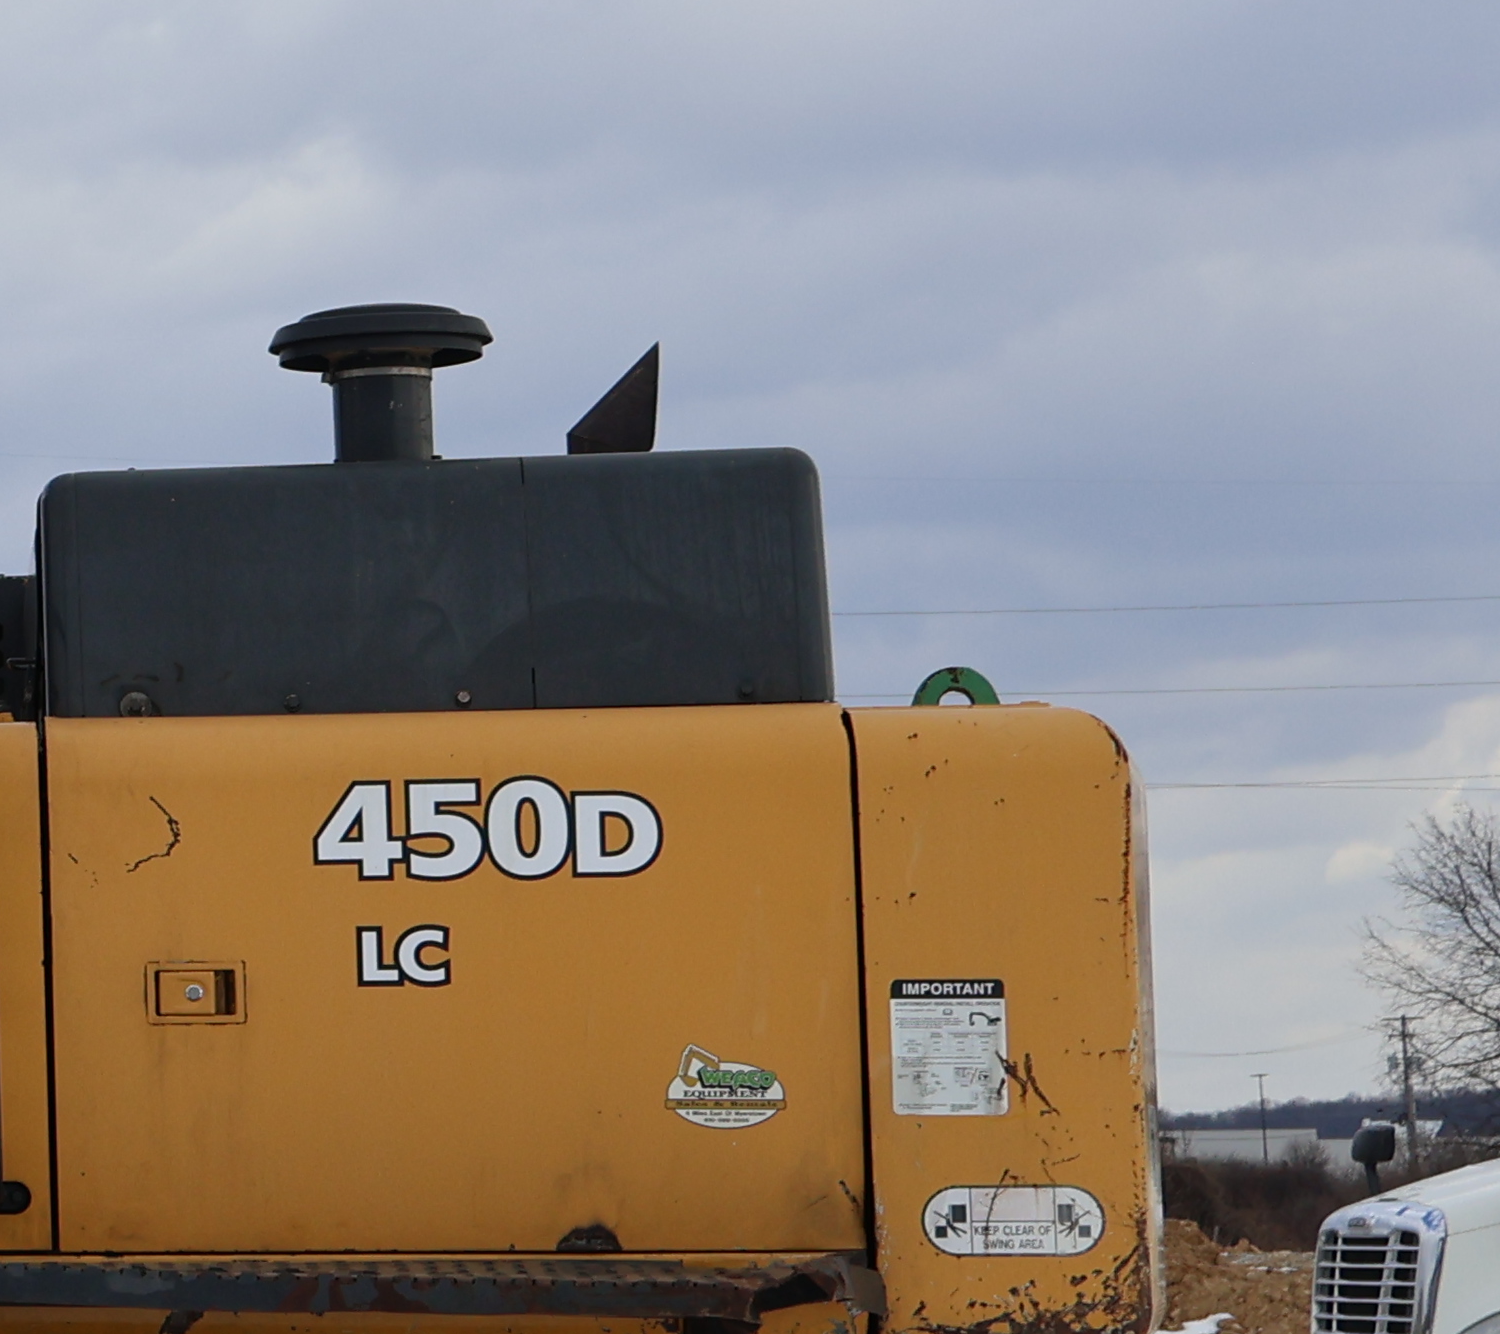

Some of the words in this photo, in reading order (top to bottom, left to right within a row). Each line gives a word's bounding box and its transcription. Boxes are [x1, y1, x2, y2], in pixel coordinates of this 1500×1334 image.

[313, 775, 663, 881] 450D
[356, 924, 451, 987] LC
[902, 982, 995, 995] IMPORTANT
[683, 1089, 768, 1100] EQUIPMENT
[974, 1226, 1000, 1236] KEEP
[1003, 1225, 1035, 1236] CLEAR
[1038, 1225, 1052, 1236] OF
[983, 1239, 1015, 1250] SWING
[1018, 1239, 1045, 1250] AREA
